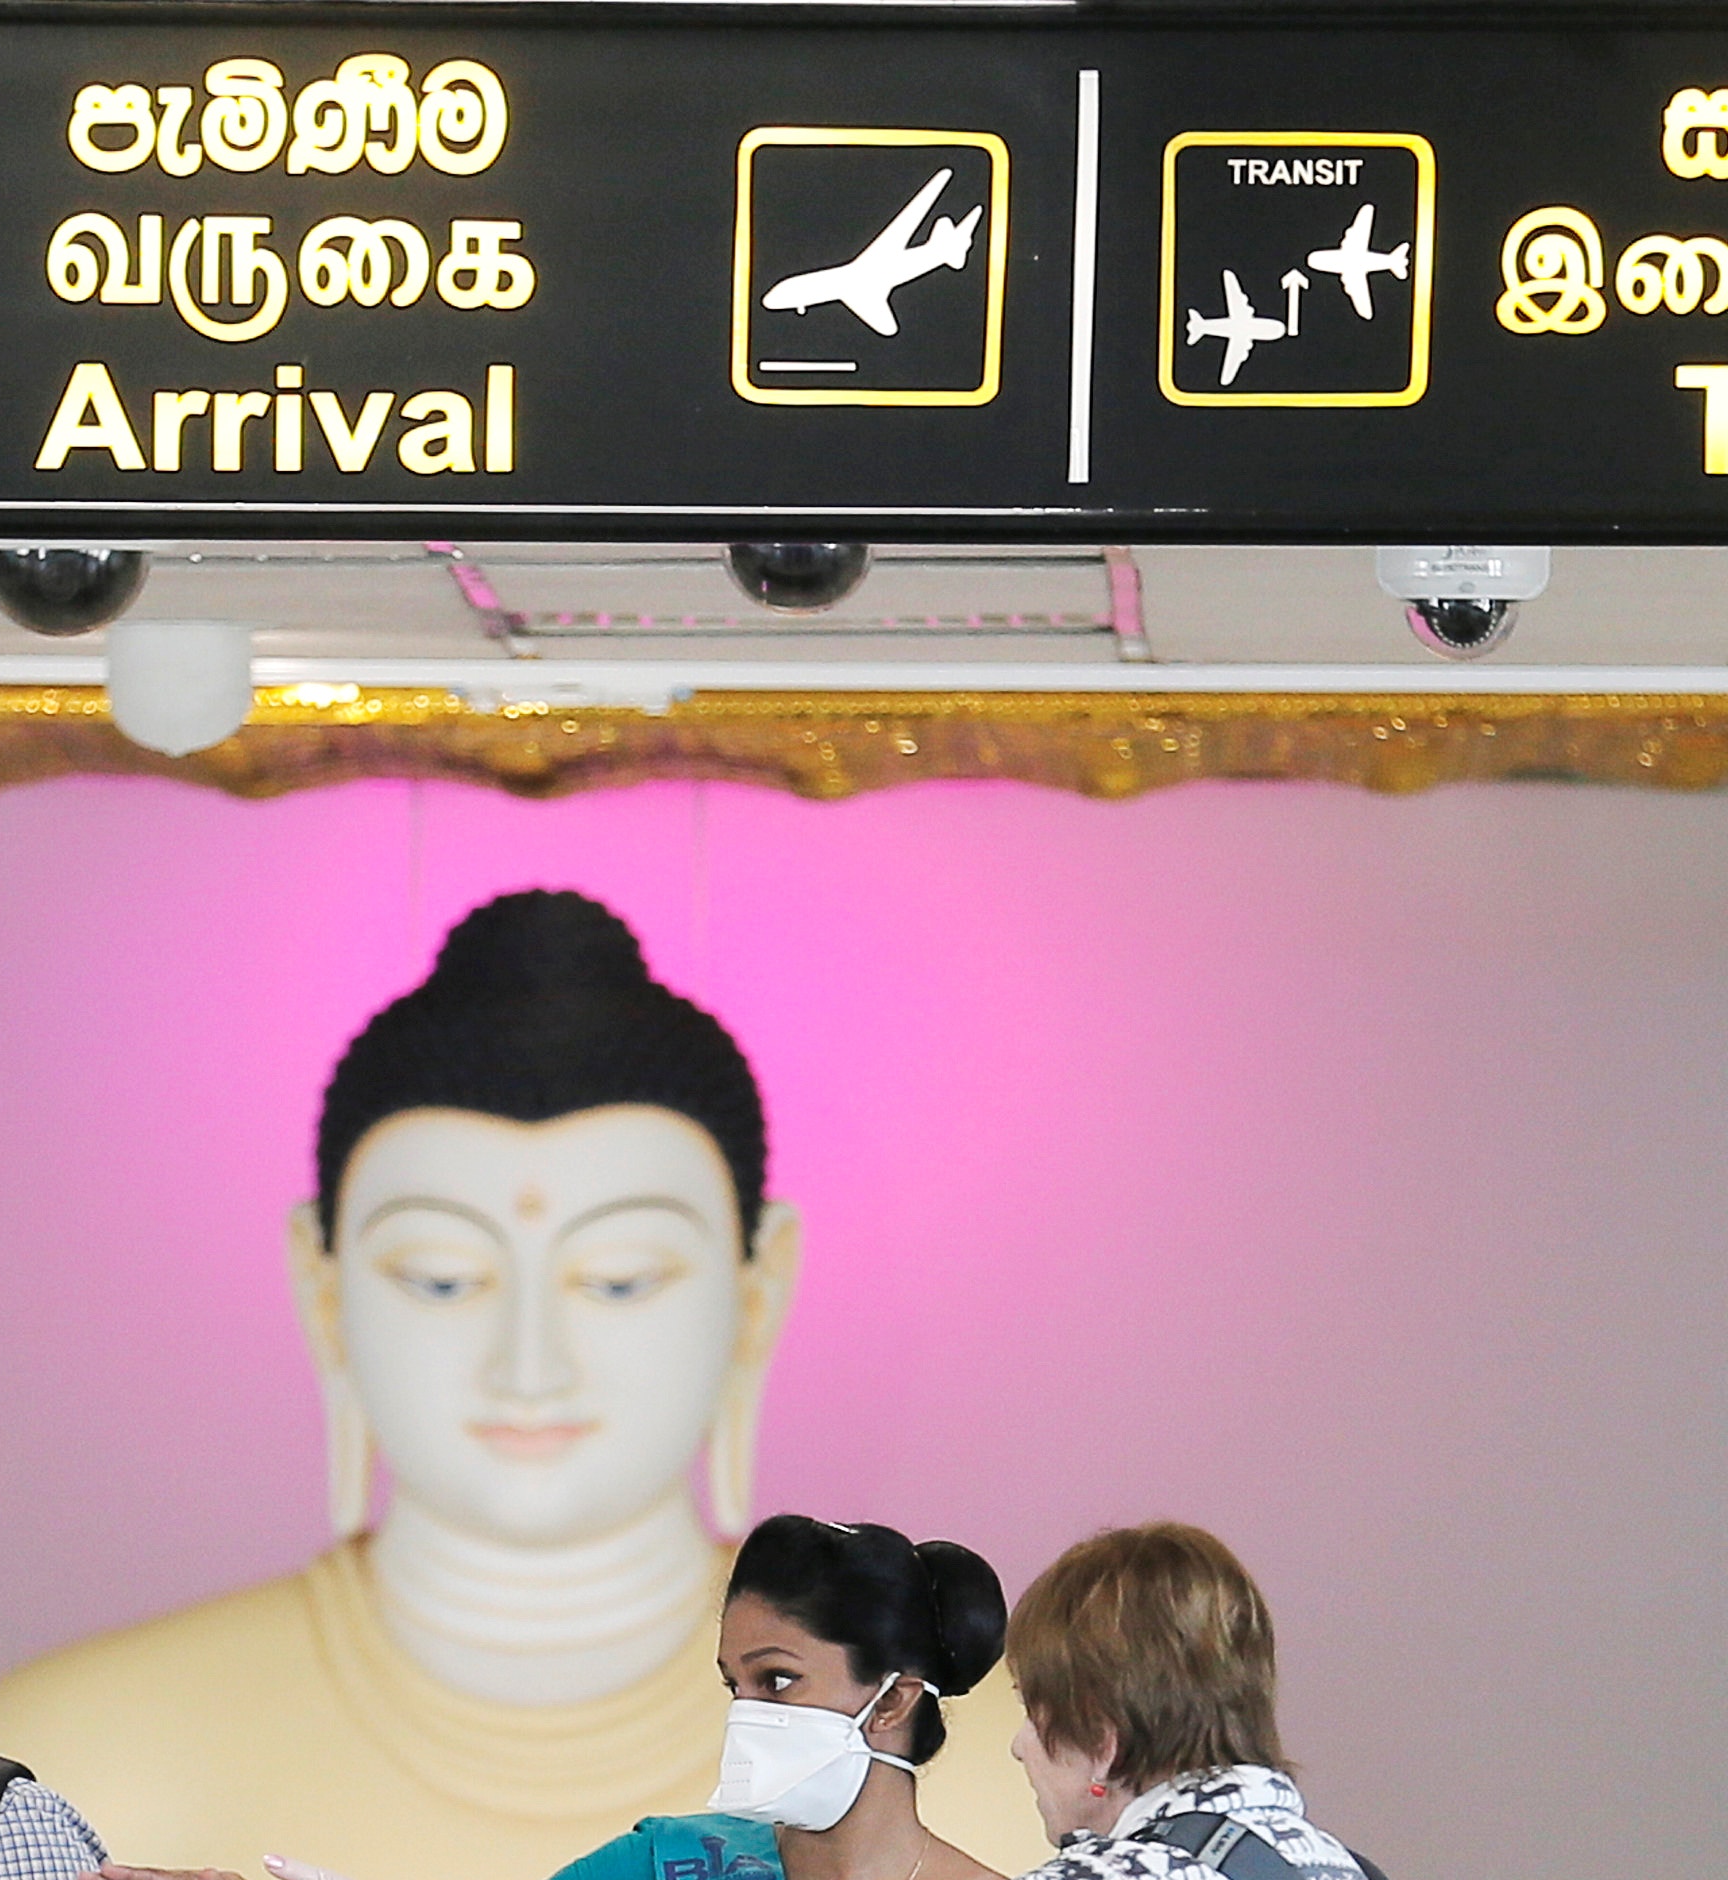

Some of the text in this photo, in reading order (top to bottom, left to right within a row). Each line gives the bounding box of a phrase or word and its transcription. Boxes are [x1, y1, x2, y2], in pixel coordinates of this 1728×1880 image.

[68, 52, 509, 176] පැමිණීම
[1227, 158, 1364, 186] TRANSIT
[46, 212, 536, 342] வருகை
[34, 361, 516, 474] Arrival
